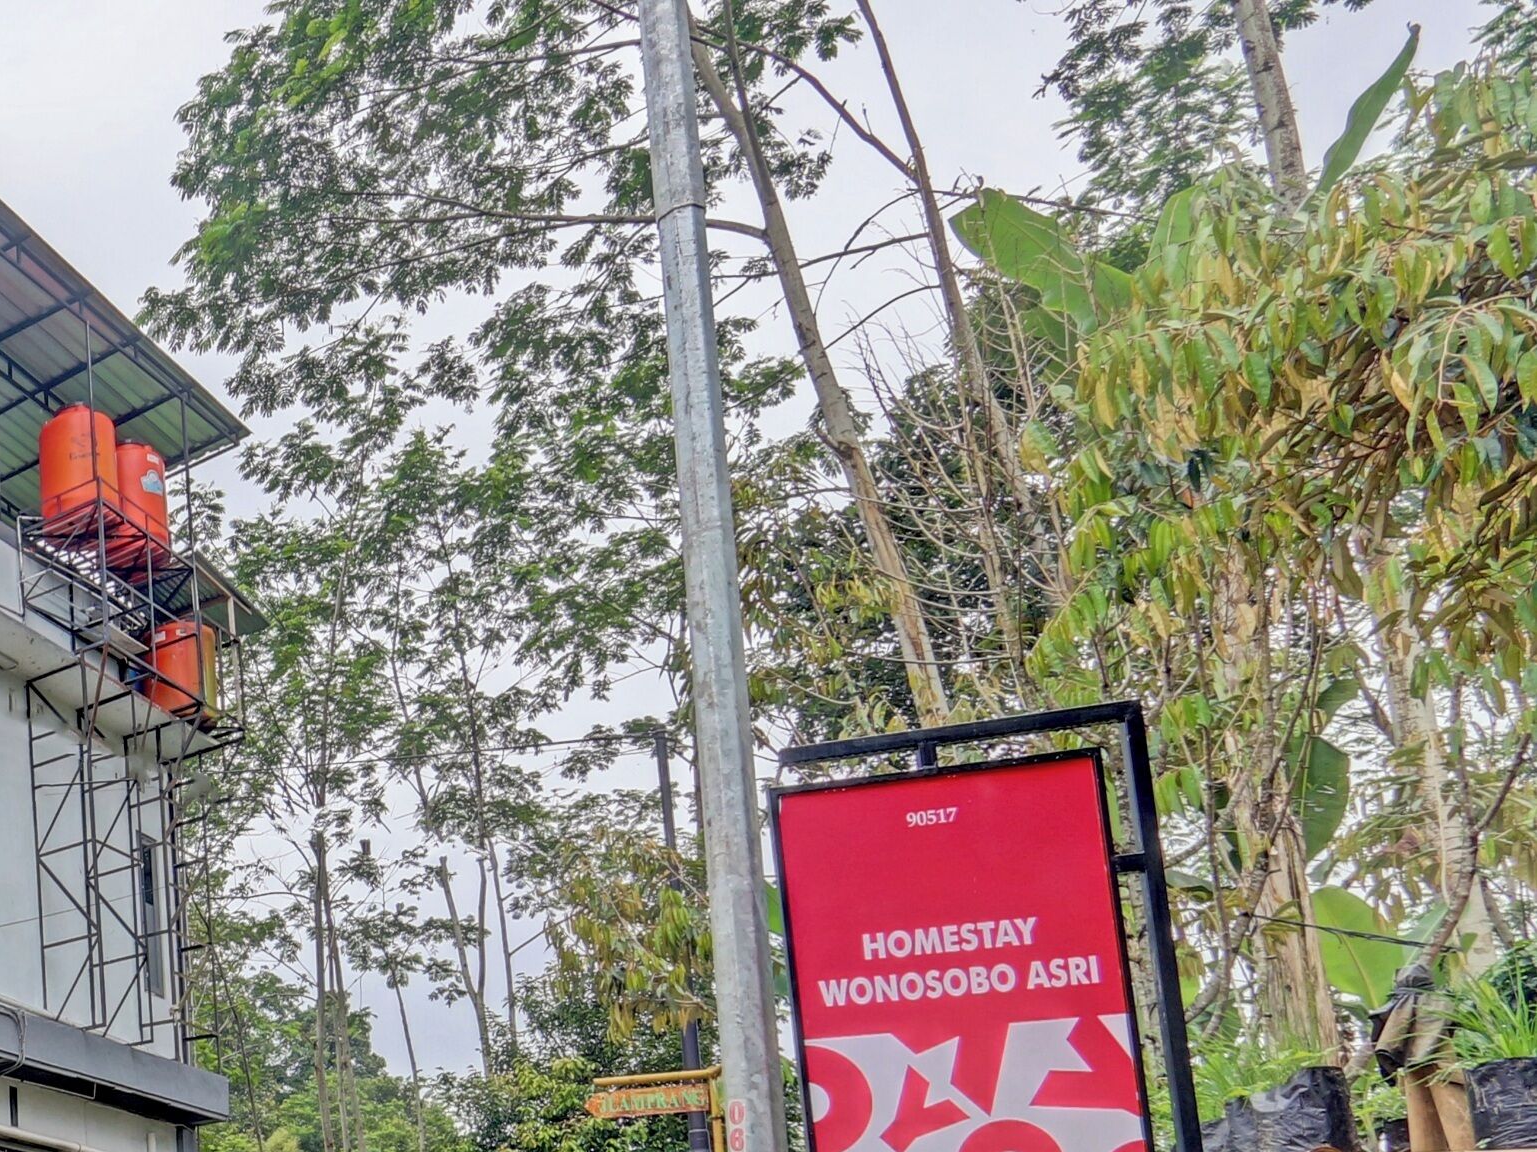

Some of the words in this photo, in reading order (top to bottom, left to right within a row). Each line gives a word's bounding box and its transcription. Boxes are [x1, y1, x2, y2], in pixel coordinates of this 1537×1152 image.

[905, 807, 958, 828] 90517
[861, 916, 1038, 961] HOMESTAY
[818, 963, 1016, 1008] WONOSOBO
[1026, 955, 1102, 990] ASRI
